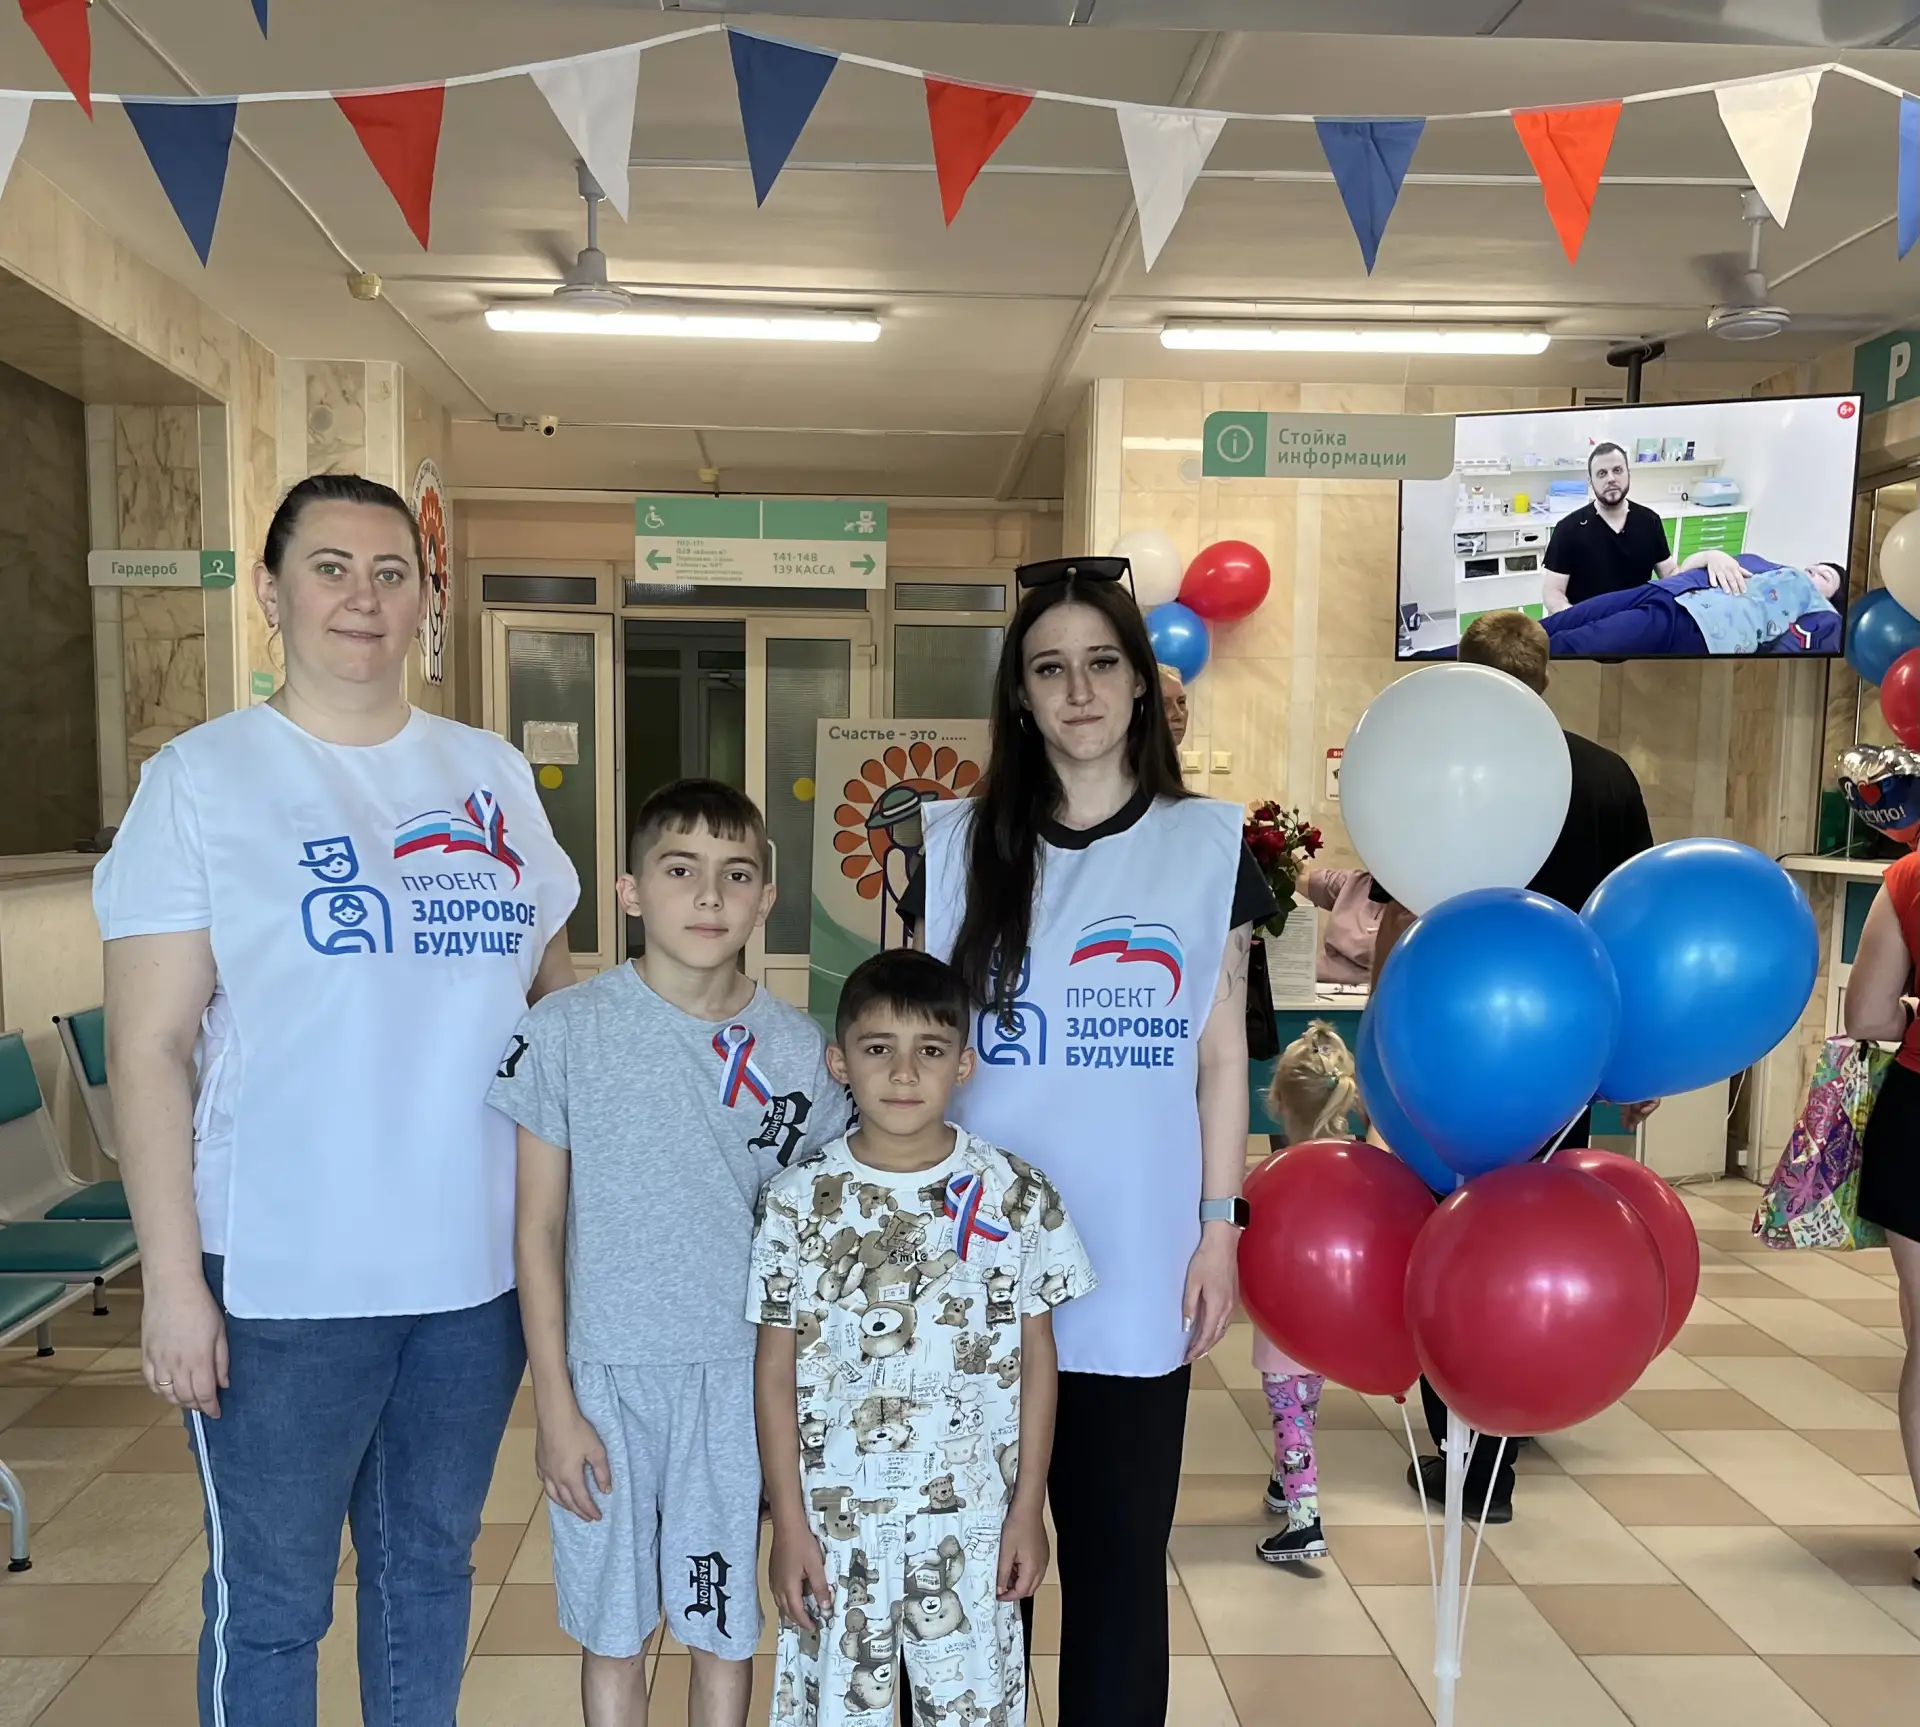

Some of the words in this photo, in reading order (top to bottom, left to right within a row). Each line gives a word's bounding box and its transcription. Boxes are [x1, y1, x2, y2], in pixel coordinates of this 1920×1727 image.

[1278, 428, 1347, 446] Стойка
[1278, 448, 1407, 469] информации
[773, 552, 818, 562] 141-148
[111, 561, 178, 578] Гардероб
[773, 564, 793, 574] 139
[795, 564, 836, 575] КАССА
[828, 726, 896, 740] Счастье
[909, 730, 938, 740] это
[401, 872, 498, 891] ПРОЕКТ
[411, 900, 536, 927] ЗДОРОВОЕ
[414, 931, 523, 956] БУДУЩЕЕ
[1066, 987, 1156, 1008] ПРОЕКТ
[1066, 1017, 1189, 1040] ЗДОРОВОЕ
[1066, 1046, 1175, 1069] БУДУЩЕЕ
[762, 1100, 785, 1142] FASHION
[698, 1560, 709, 1606] FASHION
